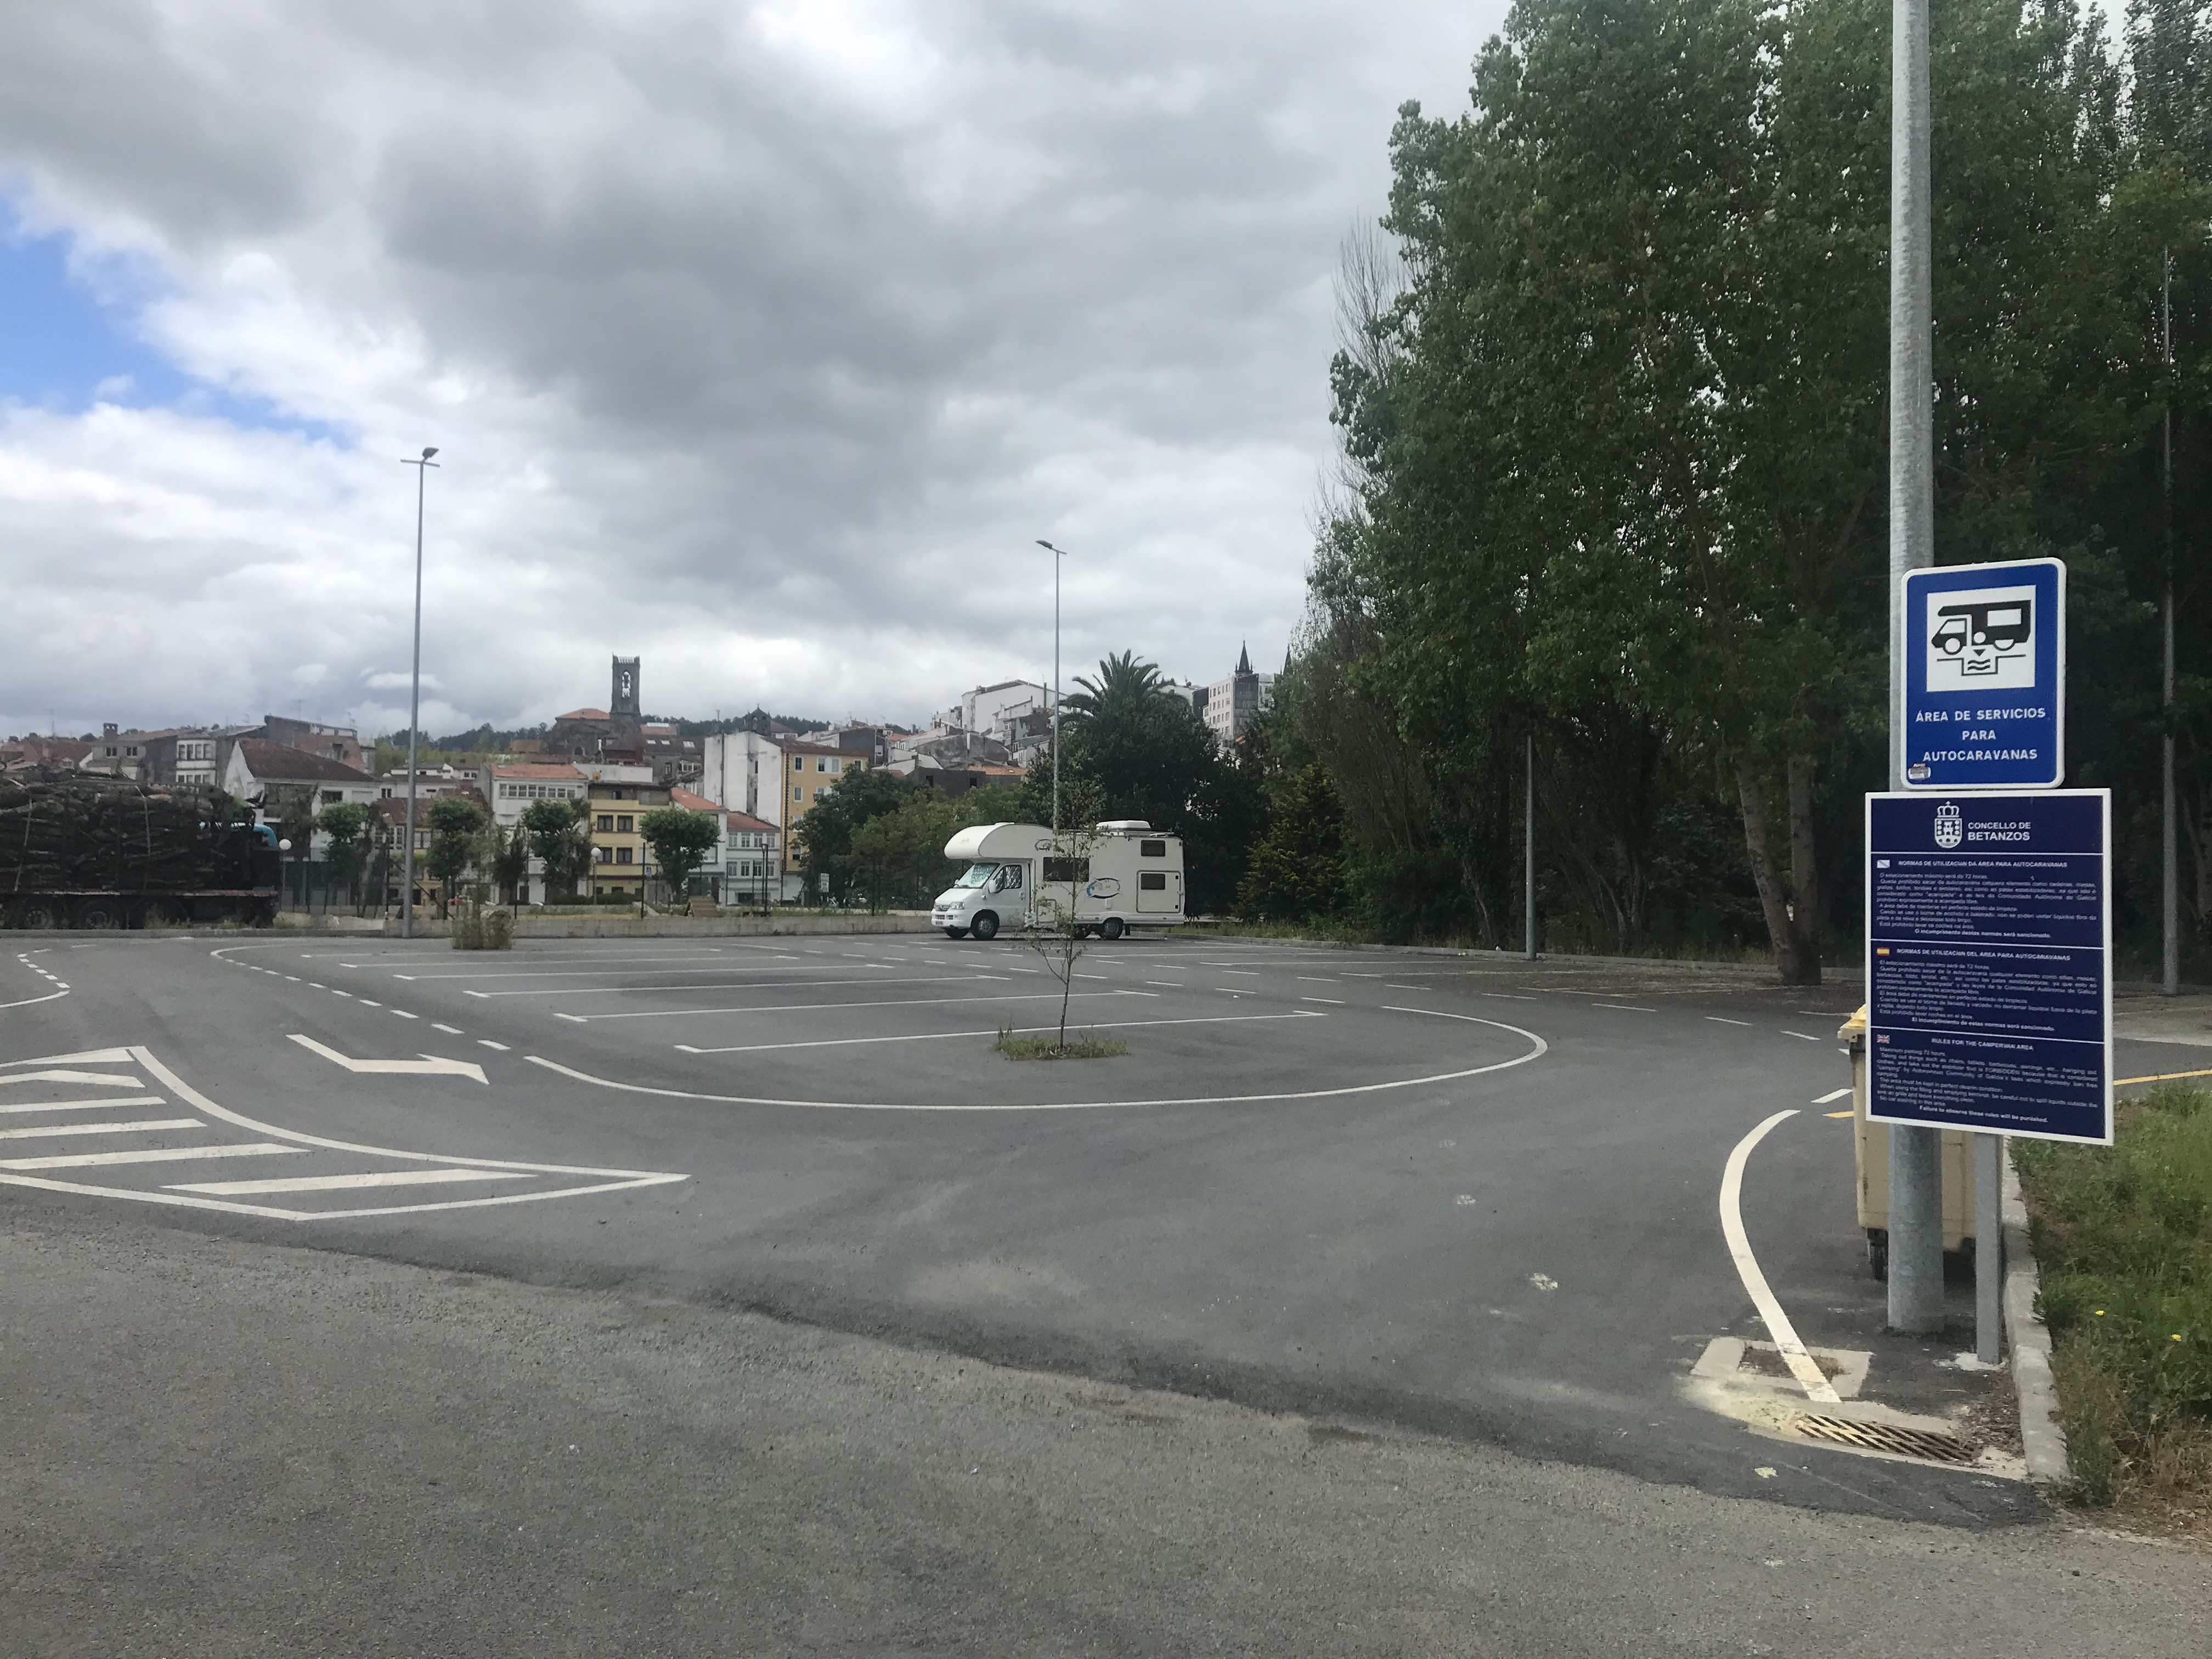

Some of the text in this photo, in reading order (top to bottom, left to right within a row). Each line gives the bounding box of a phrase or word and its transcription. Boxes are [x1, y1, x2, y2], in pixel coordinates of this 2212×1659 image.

[1916, 707, 2046, 722] ÁREA DE SERVICIOS
[1962, 729, 1996, 741] PARA
[1922, 749, 2038, 761] AUTOCARAVANAS
[1968, 832, 2030, 840] BETANZOS
